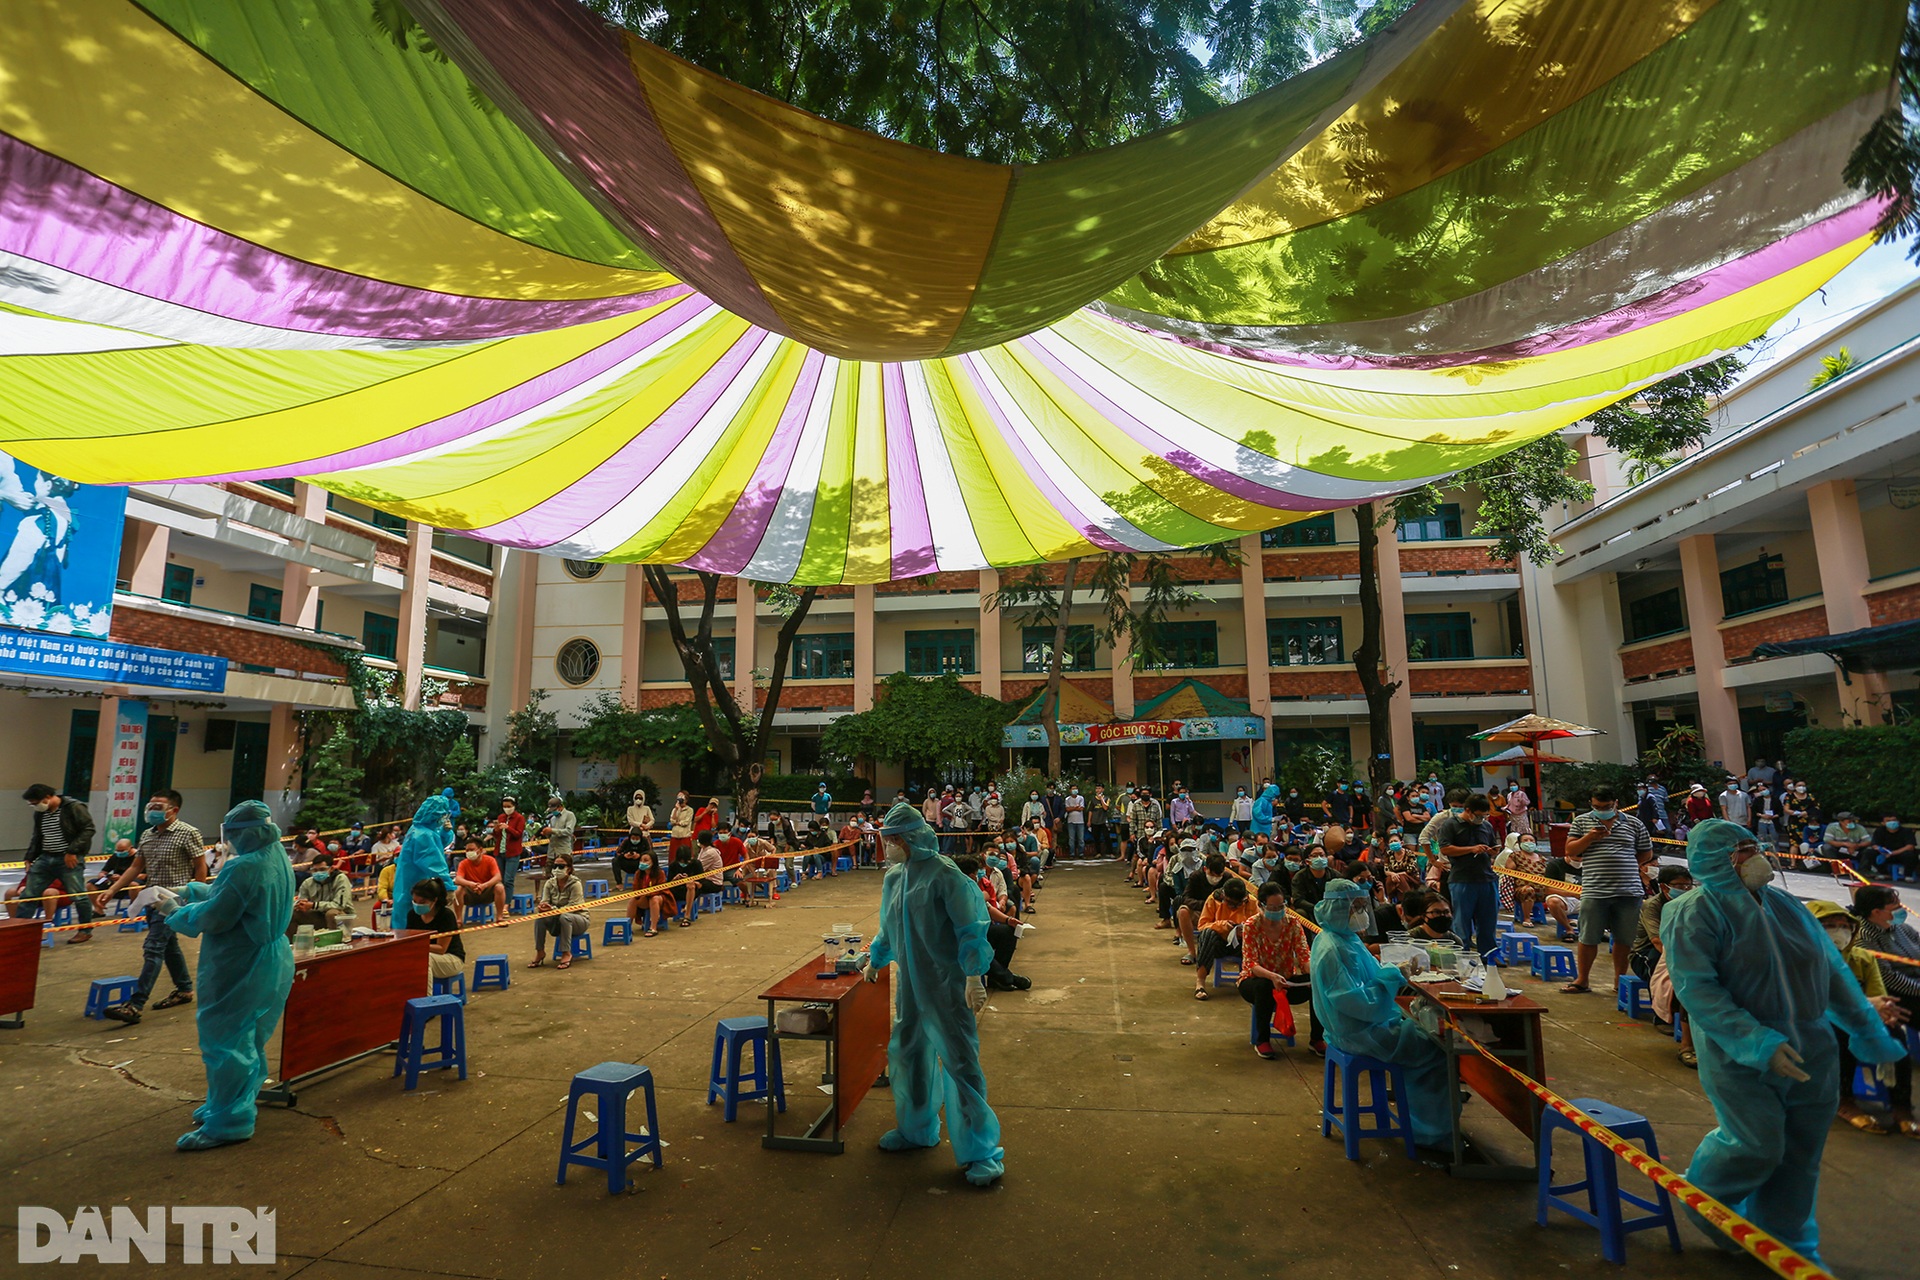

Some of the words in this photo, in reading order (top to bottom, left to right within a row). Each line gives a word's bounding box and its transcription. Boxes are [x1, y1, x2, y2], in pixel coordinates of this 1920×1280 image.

[17, 636, 37, 649] Việt
[40, 639, 61, 651] Nam
[63, 643, 75, 653] có
[77, 644, 99, 656] bước
[102, 648, 114, 657] tới
[131, 652, 147, 662] vinh
[149, 655, 172, 666] quang
[185, 659, 202, 668] sánh
[204, 662, 215, 670] vai
[19, 651, 41, 663] một
[70, 656, 87, 667] lớn
[97, 660, 120, 671] công
[122, 662, 139, 673] học
[141, 665, 155, 676] tập
[157, 666, 173, 677] của
[174, 668, 189, 678] các
[1100, 725, 1121, 740] GÓC
[1123, 725, 1147, 738] HỌC
[1149, 723, 1169, 737] TẬP
